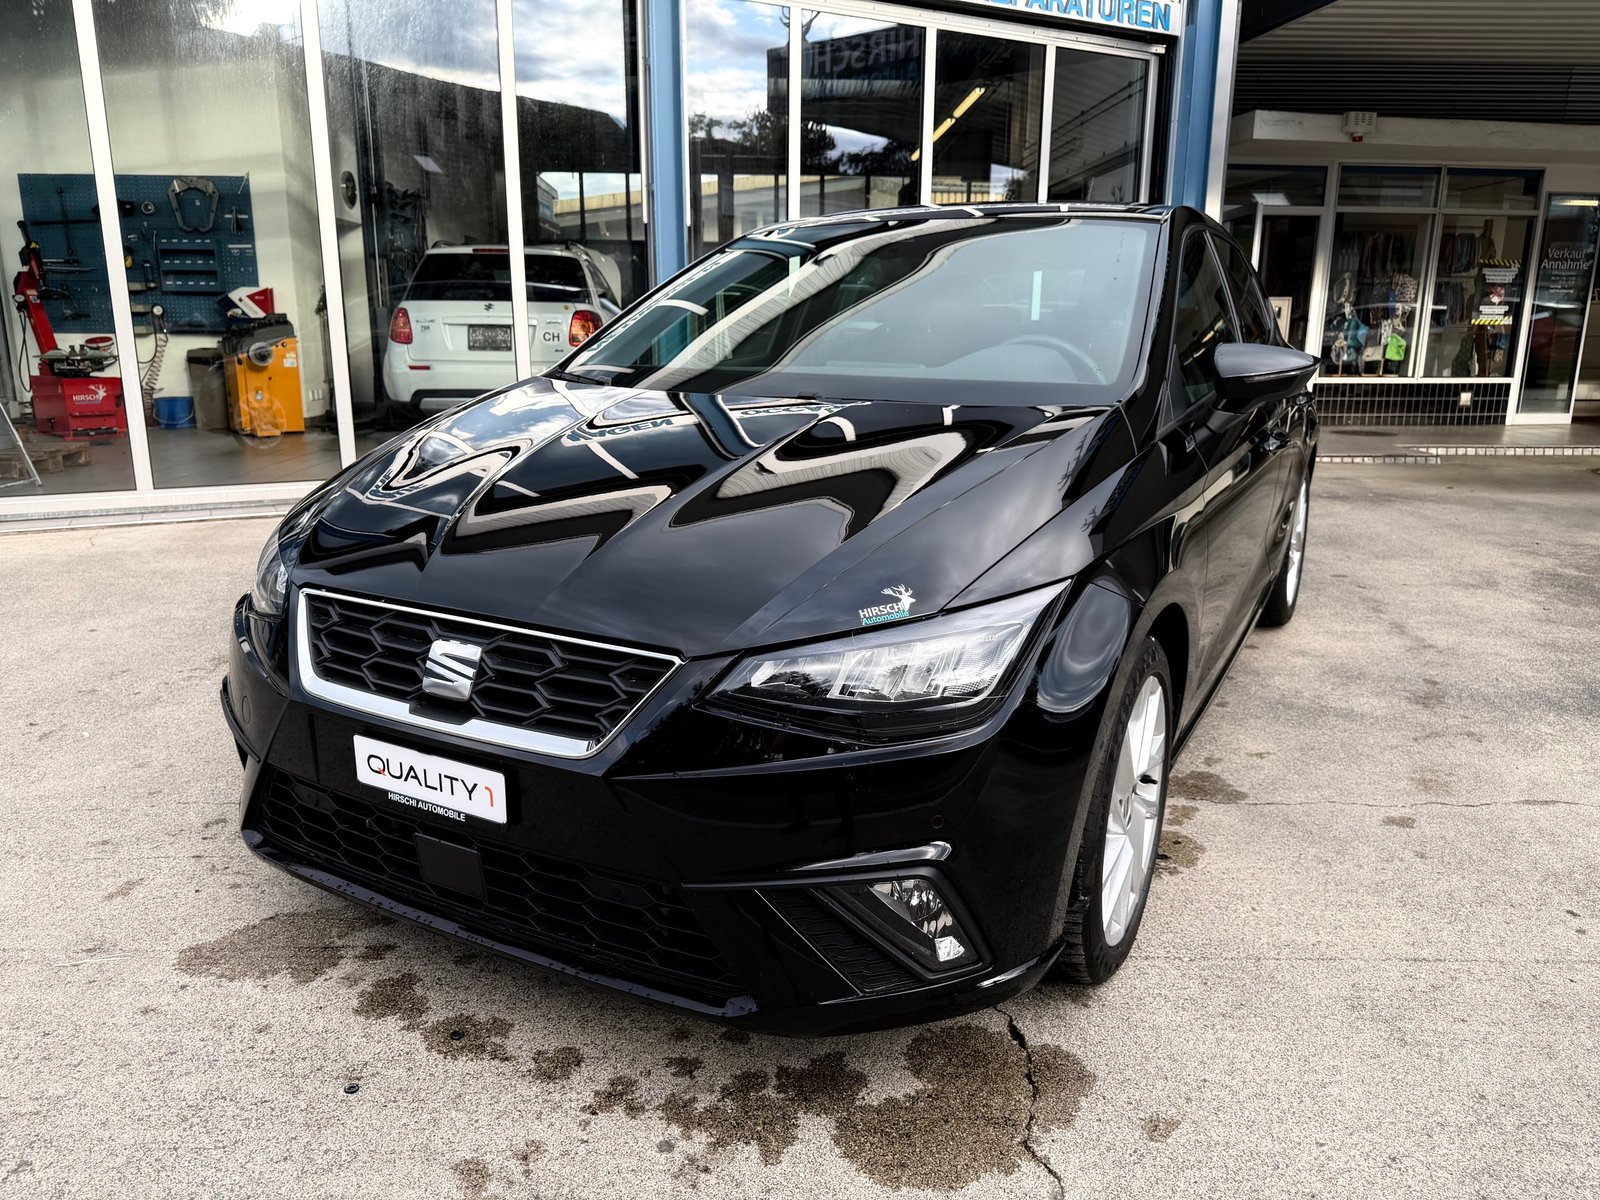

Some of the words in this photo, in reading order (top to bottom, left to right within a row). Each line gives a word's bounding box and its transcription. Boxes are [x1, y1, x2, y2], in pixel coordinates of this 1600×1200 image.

[984, 0, 1171, 31] RATUREN
[543, 331, 560, 342] CH
[861, 610, 910, 626] Automobile
[367, 754, 478, 801] QUALITY
[388, 792, 417, 807] HIRSCHI
[418, 801, 466, 822] AUTOMOBILE
